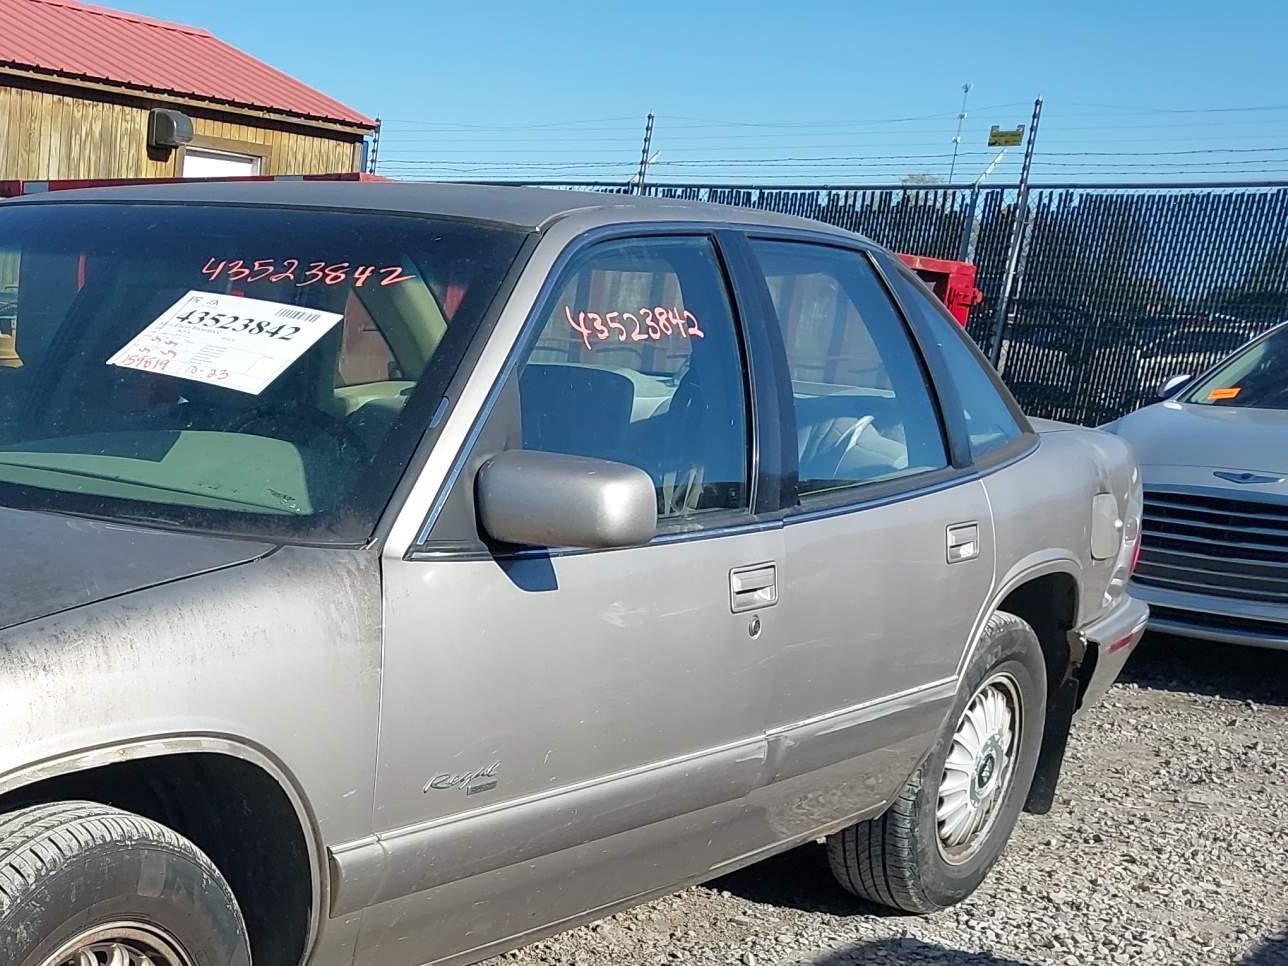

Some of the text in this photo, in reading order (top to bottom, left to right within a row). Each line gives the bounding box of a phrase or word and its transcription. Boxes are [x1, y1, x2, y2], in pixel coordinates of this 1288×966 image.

[201, 257, 416, 287] 43523842
[176, 309, 302, 341] 43523842
[565, 305, 705, 350] 43523842
